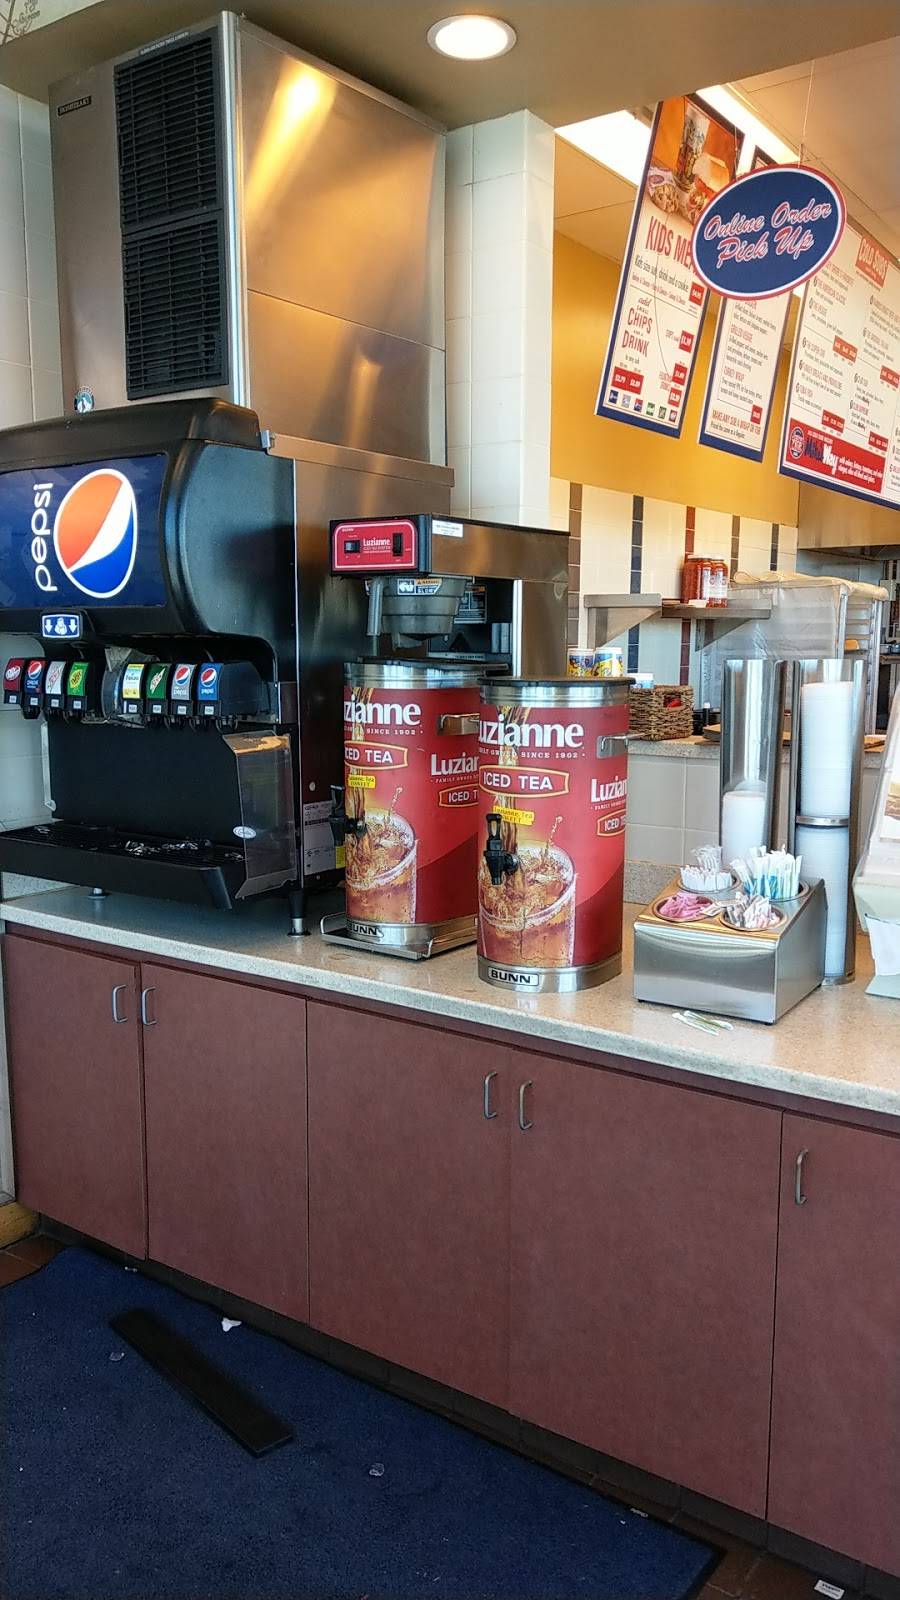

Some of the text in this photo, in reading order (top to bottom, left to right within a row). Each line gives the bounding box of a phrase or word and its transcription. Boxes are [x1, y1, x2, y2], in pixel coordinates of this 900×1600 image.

[704, 198, 832, 240] Online Order
[646, 216, 697, 272] KIDS ME
[717, 226, 815, 269] Pick Up
[627, 307, 653, 334] CHIPS
[622, 330, 649, 357] DRINK
[823, 443, 839, 475] Way
[31, 482, 58, 592] pepsi
[362, 537, 391, 547] Luzianne
[344, 694, 421, 726] zianne
[365, 749, 393, 763] TEA
[521, 751, 550, 759] SINCE
[483, 771, 553, 790] ICED TEA
[448, 790, 470, 803] ICED
[491, 969, 531, 984] BUNN
